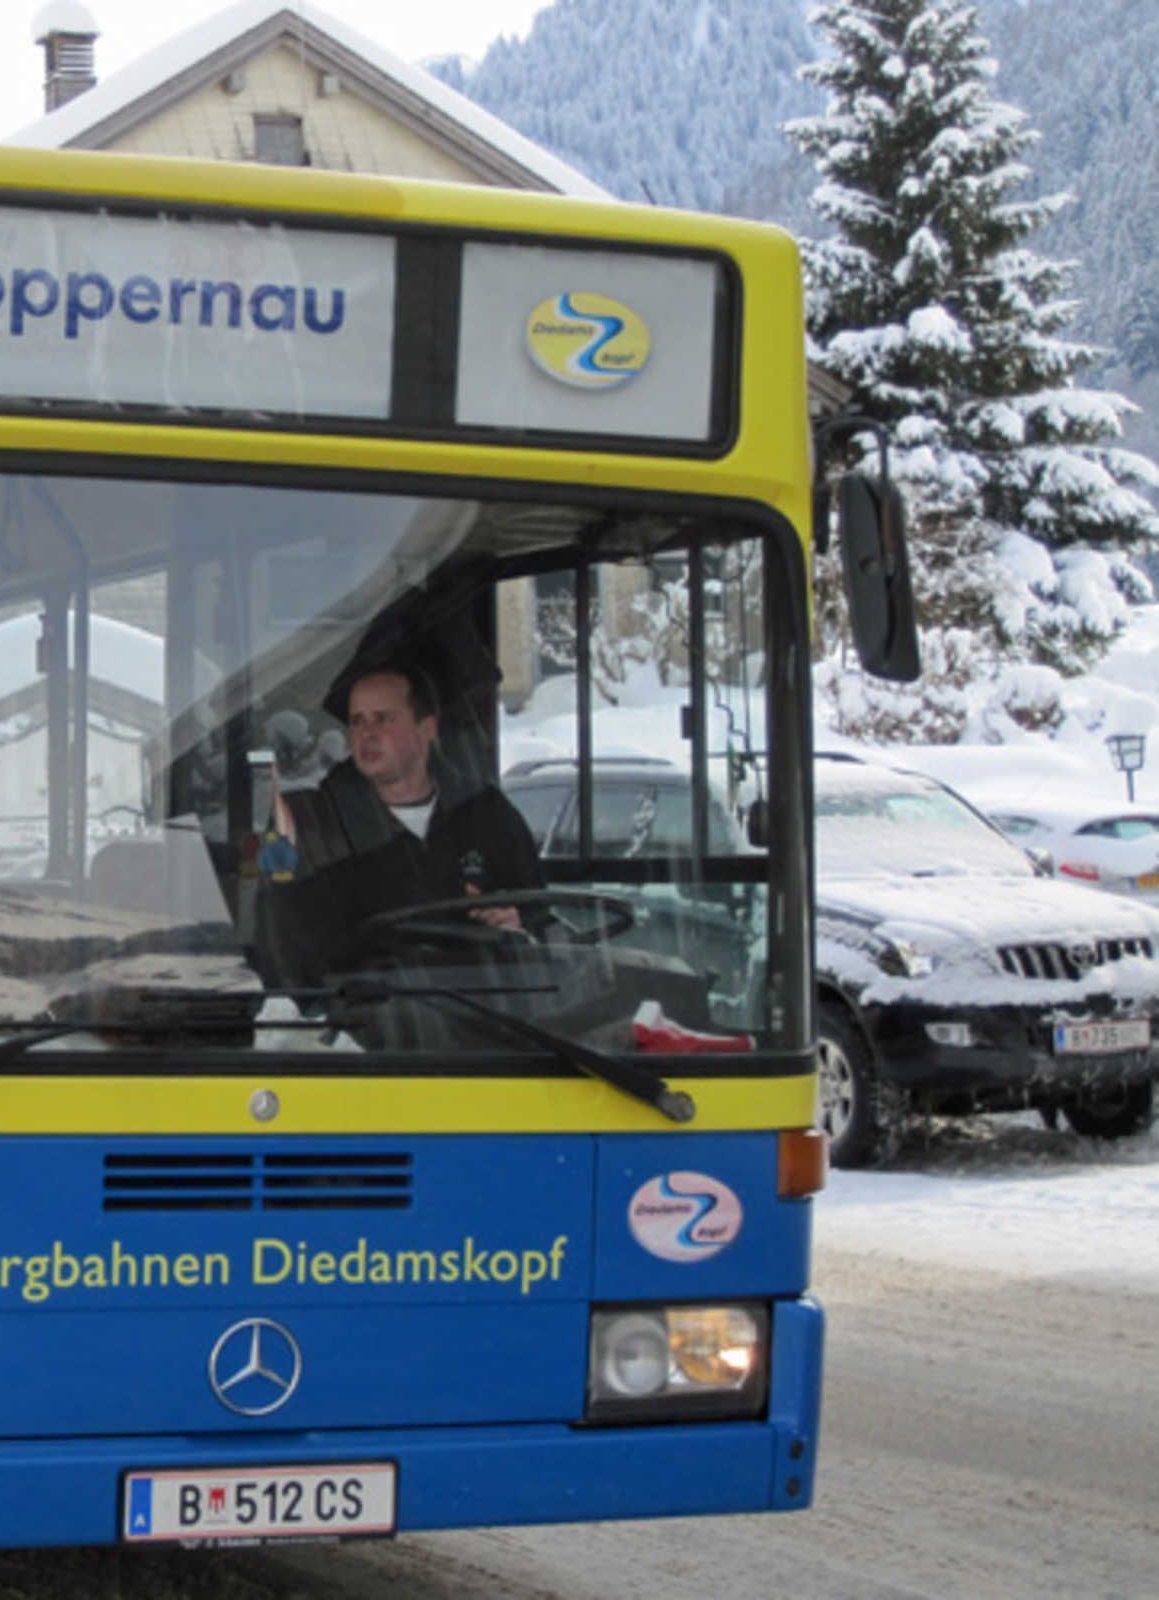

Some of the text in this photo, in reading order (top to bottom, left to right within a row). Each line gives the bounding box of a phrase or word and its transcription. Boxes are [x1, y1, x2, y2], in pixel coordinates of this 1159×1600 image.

[252, 1236, 569, 1295] Diedamskopf
[179, 1478, 363, 1526] B 512 CS
